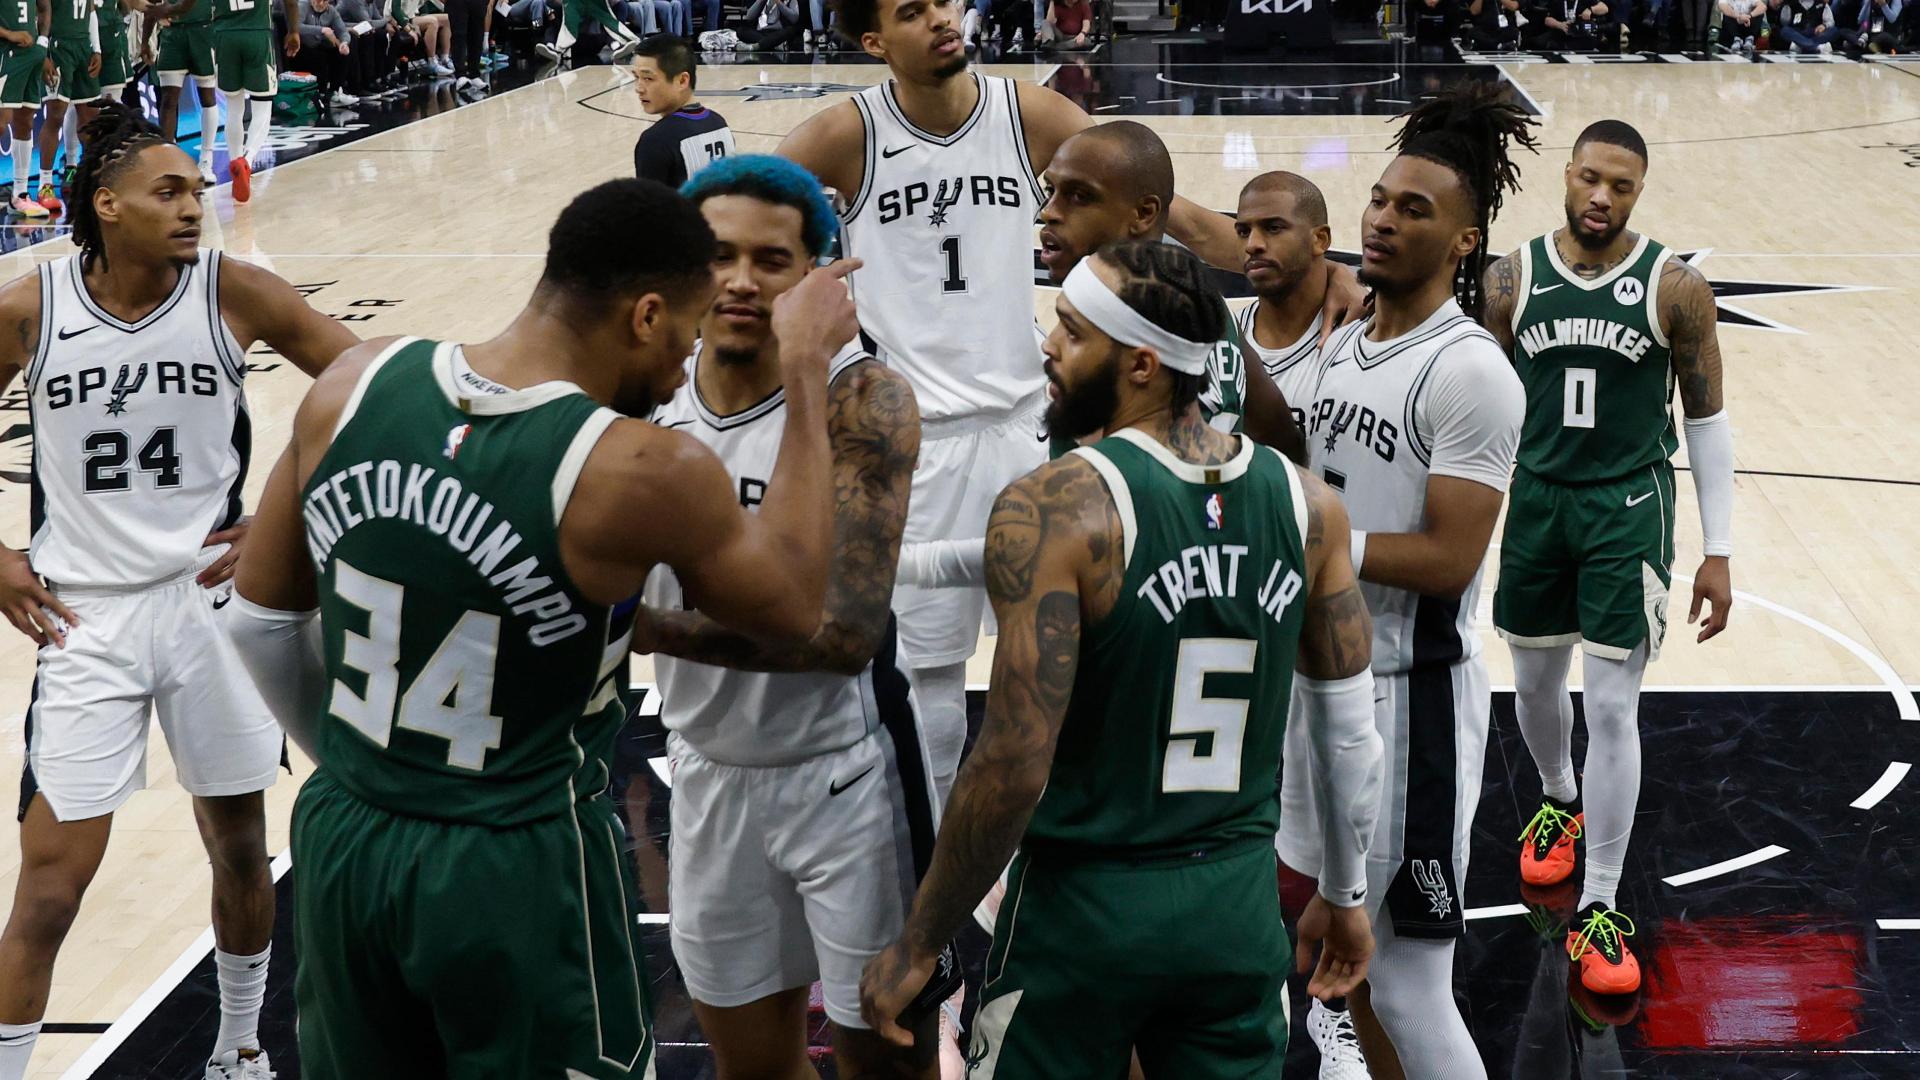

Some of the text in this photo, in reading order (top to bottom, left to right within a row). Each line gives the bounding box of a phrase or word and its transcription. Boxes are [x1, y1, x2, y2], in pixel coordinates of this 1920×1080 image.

[17, 2, 28, 23] 3
[878, 175, 1020, 228] SPURS
[939, 234, 970, 295] 1
[1518, 317, 1653, 363] MILWAUKEE
[47, 361, 218, 417] SPURS
[461, 372, 489, 391] NIKE
[1563, 367, 1597, 429] 0
[82, 425, 183, 494] 24
[303, 459, 588, 648] ANTETOKOUNMPO
[1137, 544, 1303, 624] TRENT JR
[328, 558, 504, 772] 34
[1162, 637, 1258, 794] 5
